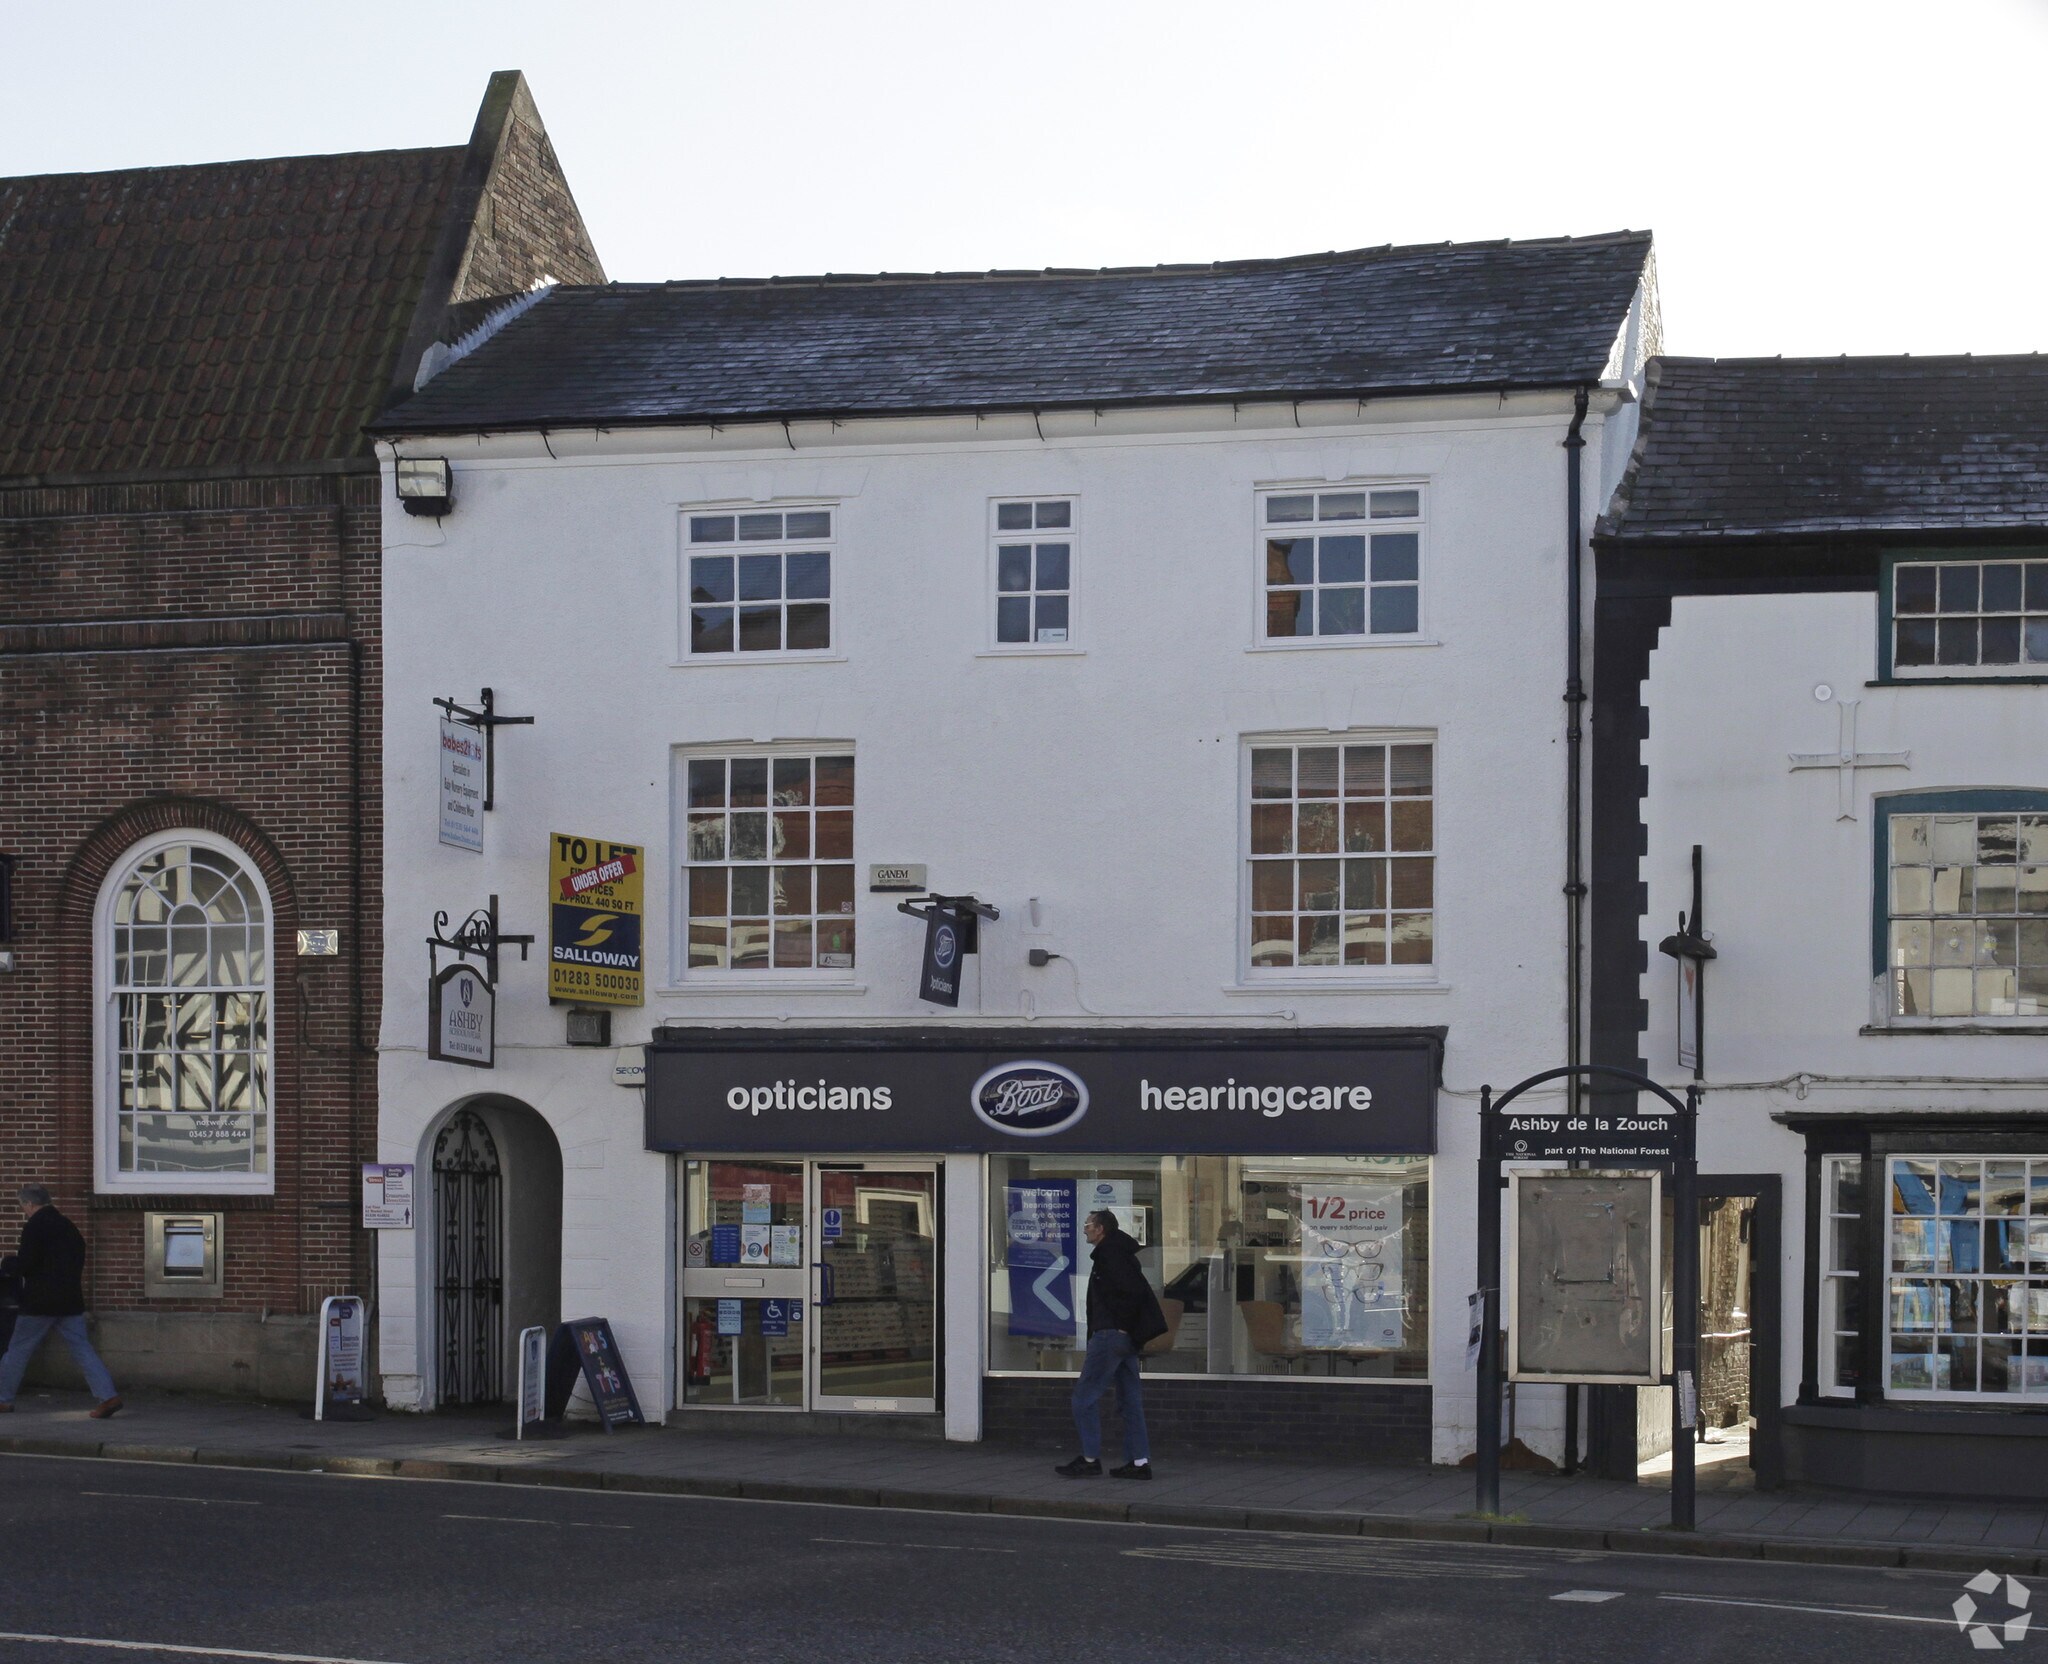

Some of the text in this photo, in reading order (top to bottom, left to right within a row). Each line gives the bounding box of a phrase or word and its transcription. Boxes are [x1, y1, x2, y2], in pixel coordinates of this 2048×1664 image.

[463, 783, 479, 799] Equipment
[558, 836, 588, 865] TO
[571, 869, 600, 892] UNDER
[599, 860, 624, 881] OFFER
[877, 869, 909, 879] GANEM
[596, 897, 610, 908] 440
[612, 899, 623, 910] SQ
[625, 901, 634, 911] FT
[553, 946, 639, 968] SALLOWAY
[553, 968, 639, 991] 01283 500030
[555, 986, 638, 1000] www.salloway.com
[449, 1009, 483, 1032] ASHBY
[727, 1079, 893, 1117] opticians
[989, 1078, 1063, 1117] Boots
[1140, 1079, 1372, 1118] hearingcare
[1509, 1117, 1668, 1133] Ashby de la Zouch
[189, 1130, 247, 1138] 0345 7 888 444
[1544, 1146, 1669, 1155] part of The National Forest
[1022, 1187, 1070, 1197] welcome
[1023, 1202, 1070, 1210] hearingcare
[1307, 1196, 1386, 1222] 1/2 price
[1047, 1211, 1070, 1219] check
[1041, 1221, 1070, 1229] glasses
[1015, 1231, 1070, 1239] contact lenses
